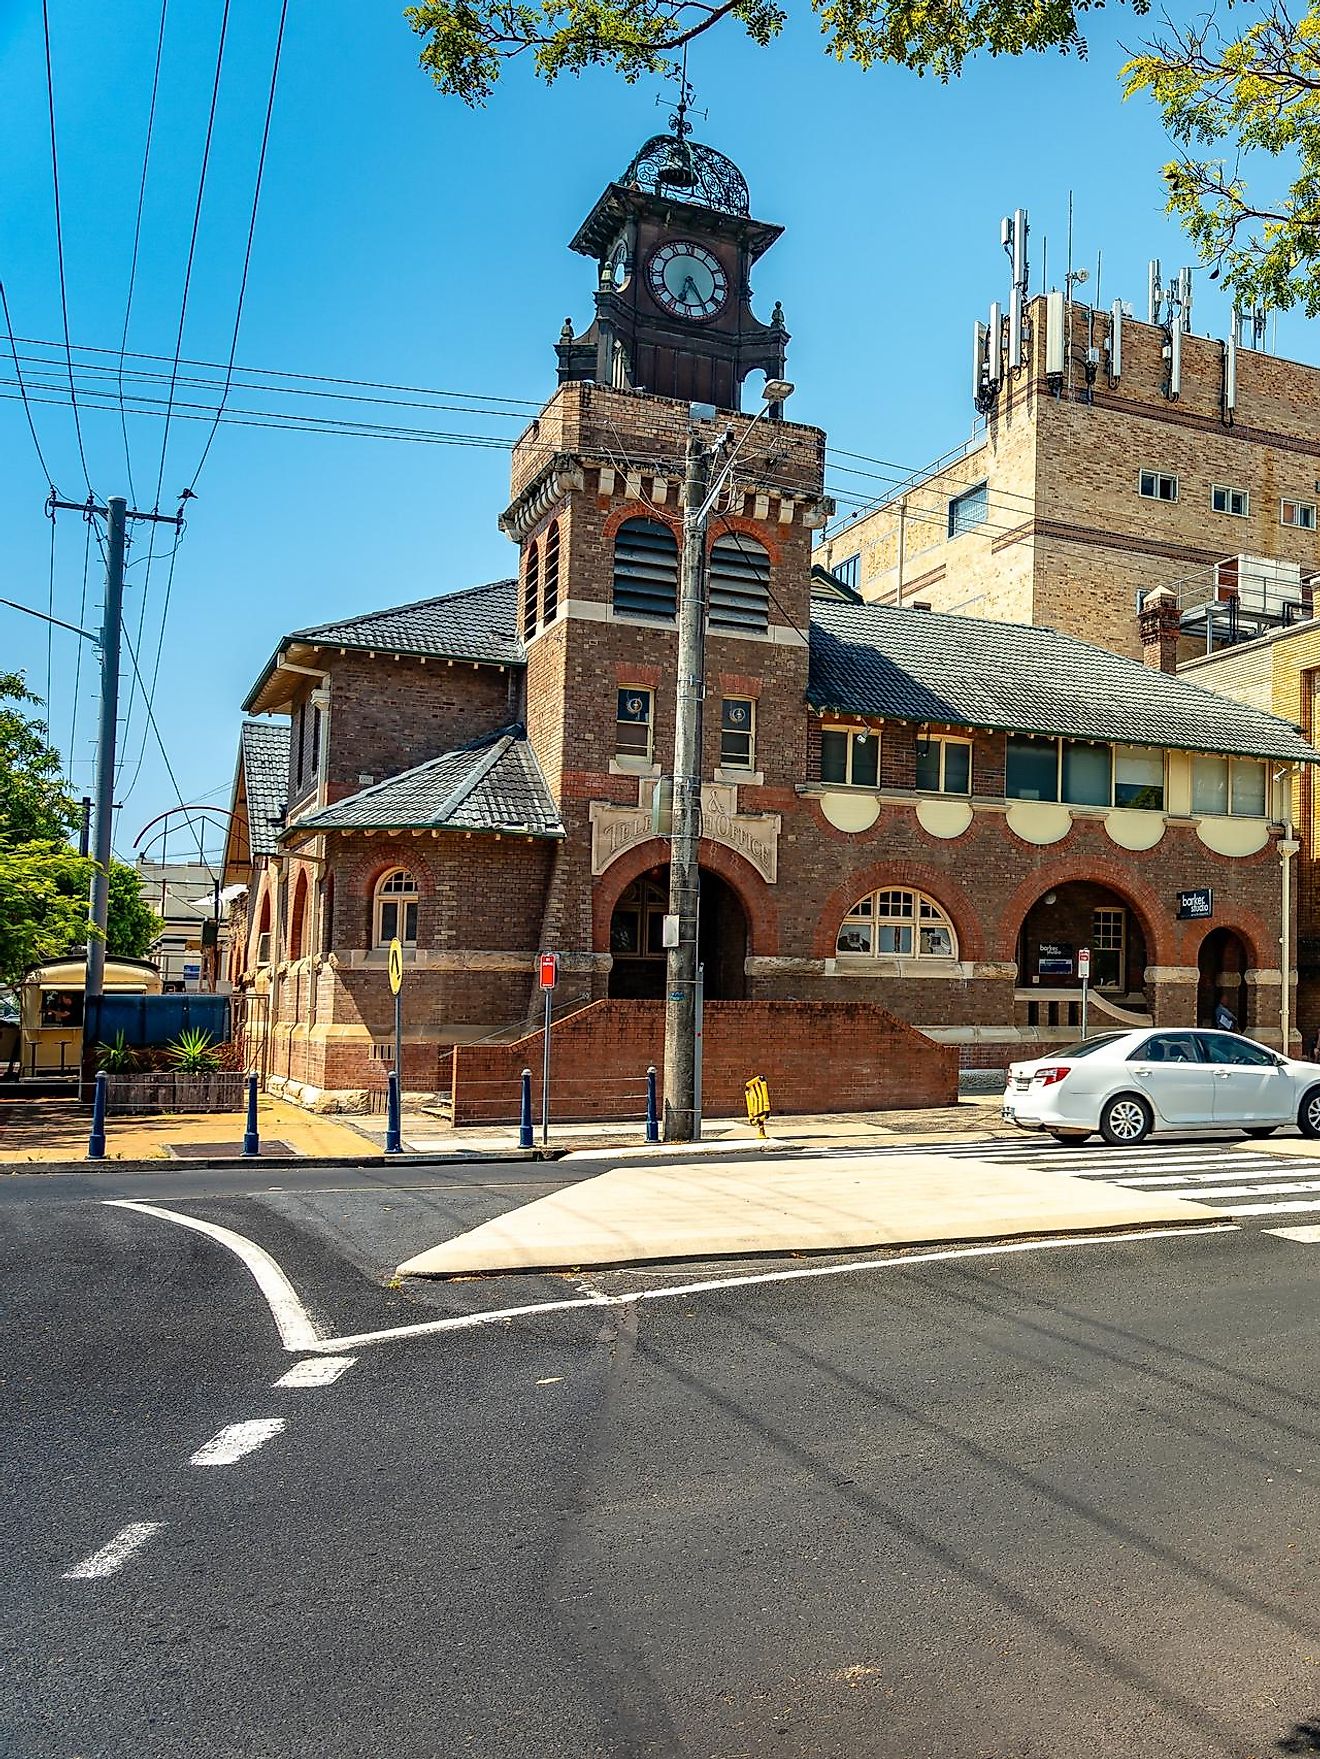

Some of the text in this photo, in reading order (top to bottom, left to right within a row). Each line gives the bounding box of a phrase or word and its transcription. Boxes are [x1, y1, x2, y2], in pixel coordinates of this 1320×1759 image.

[717, 814, 770, 867] OFFICE
[1182, 892, 1206, 907] barker
[1190, 904, 1209, 912] studio
